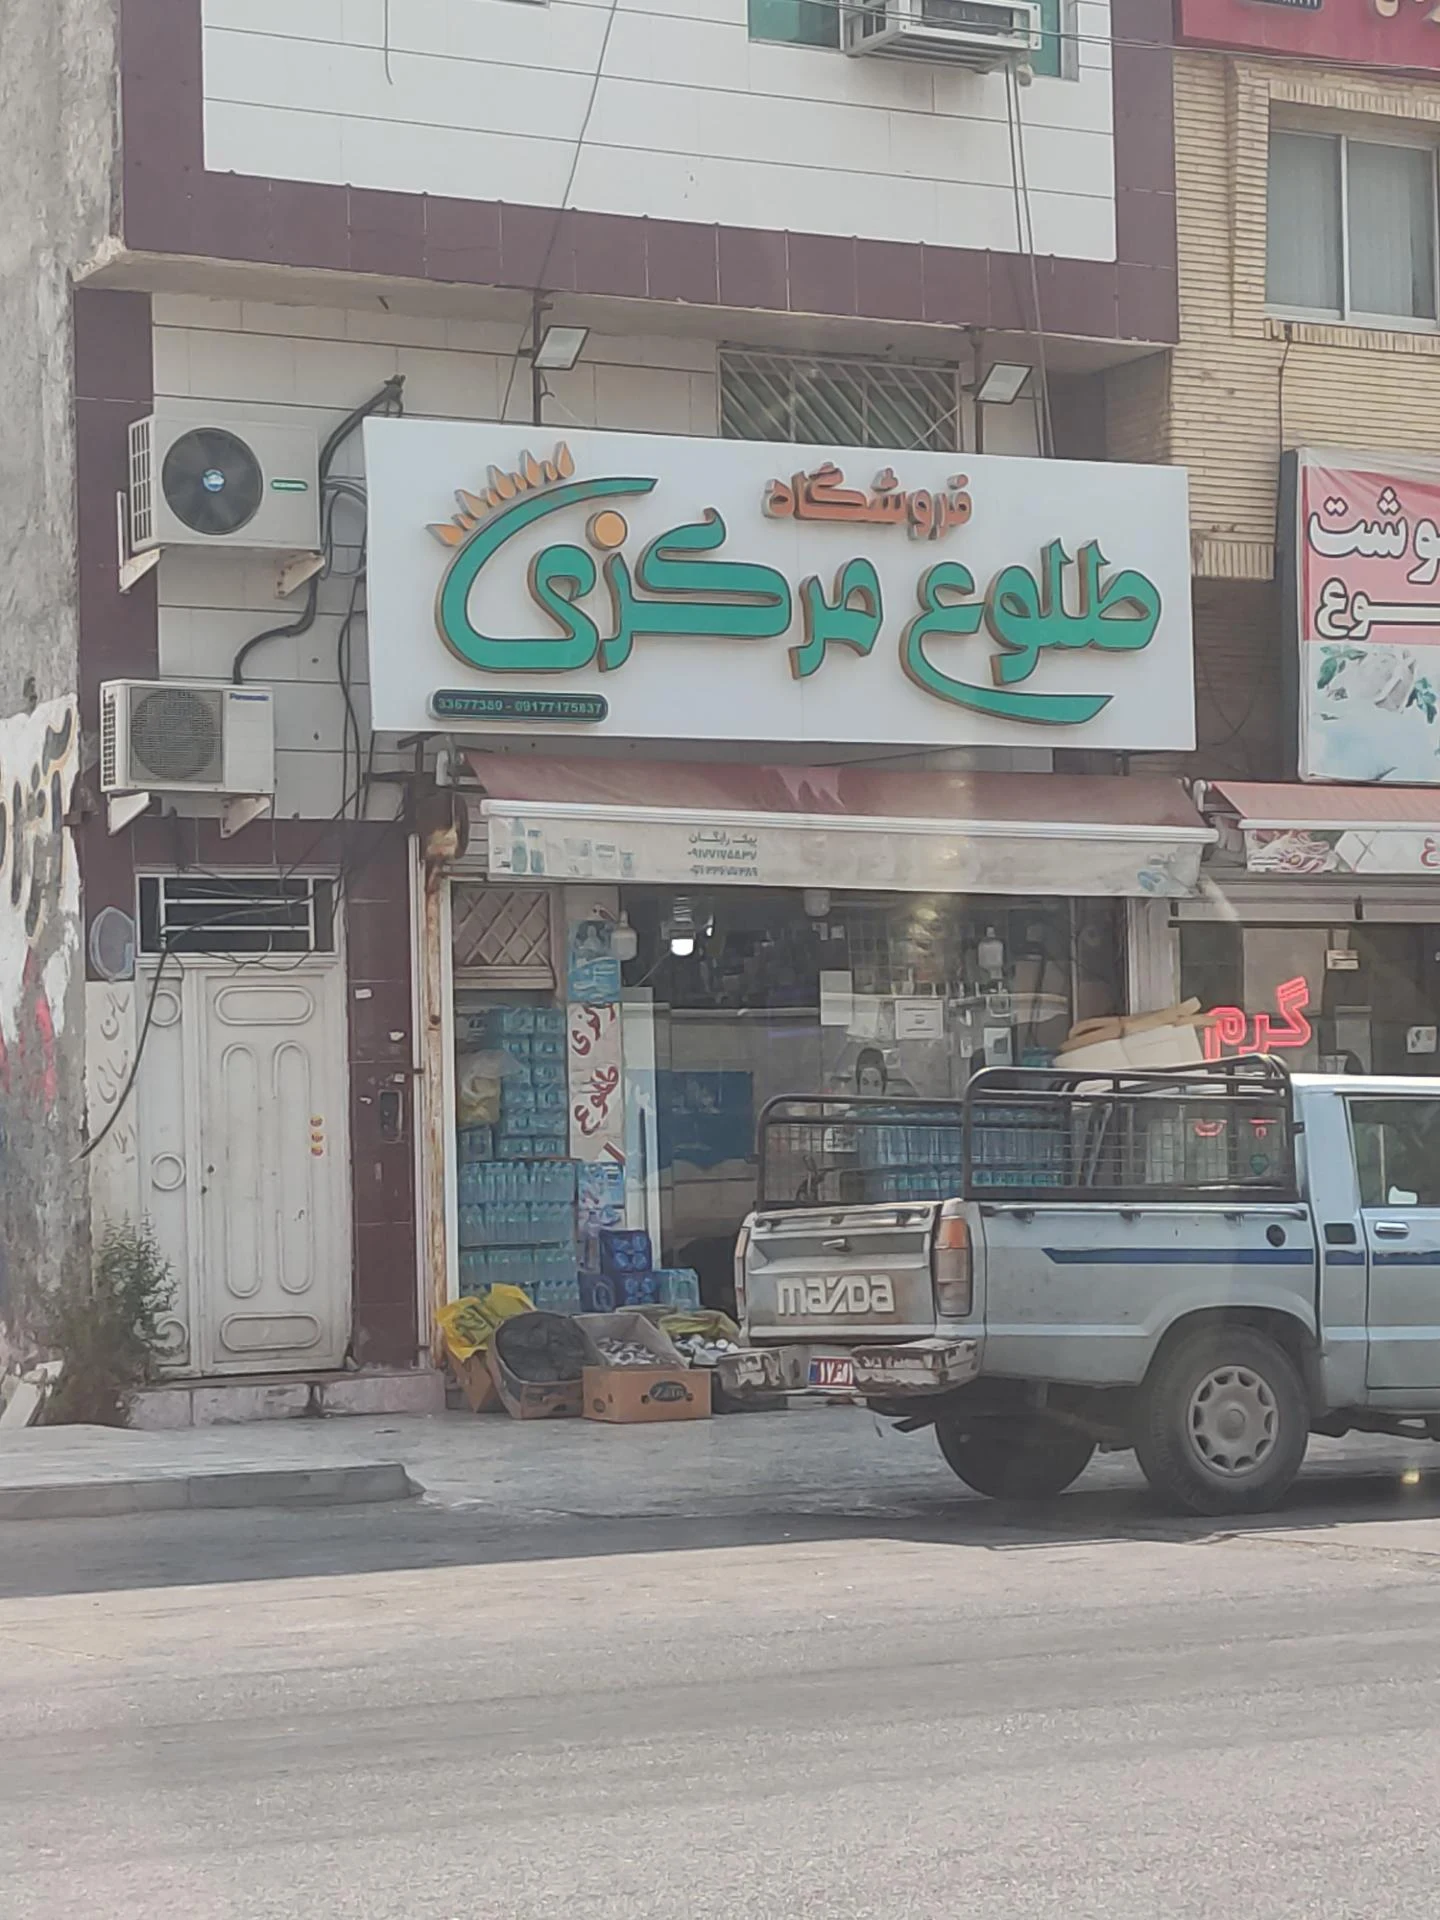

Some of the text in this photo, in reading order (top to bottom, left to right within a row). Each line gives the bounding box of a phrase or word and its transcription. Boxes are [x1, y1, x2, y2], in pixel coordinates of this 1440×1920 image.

[761, 462, 973, 540] فروشگاه
[1308, 486, 1440, 584] وشت
[434, 477, 1162, 725] طلوع مرکزی
